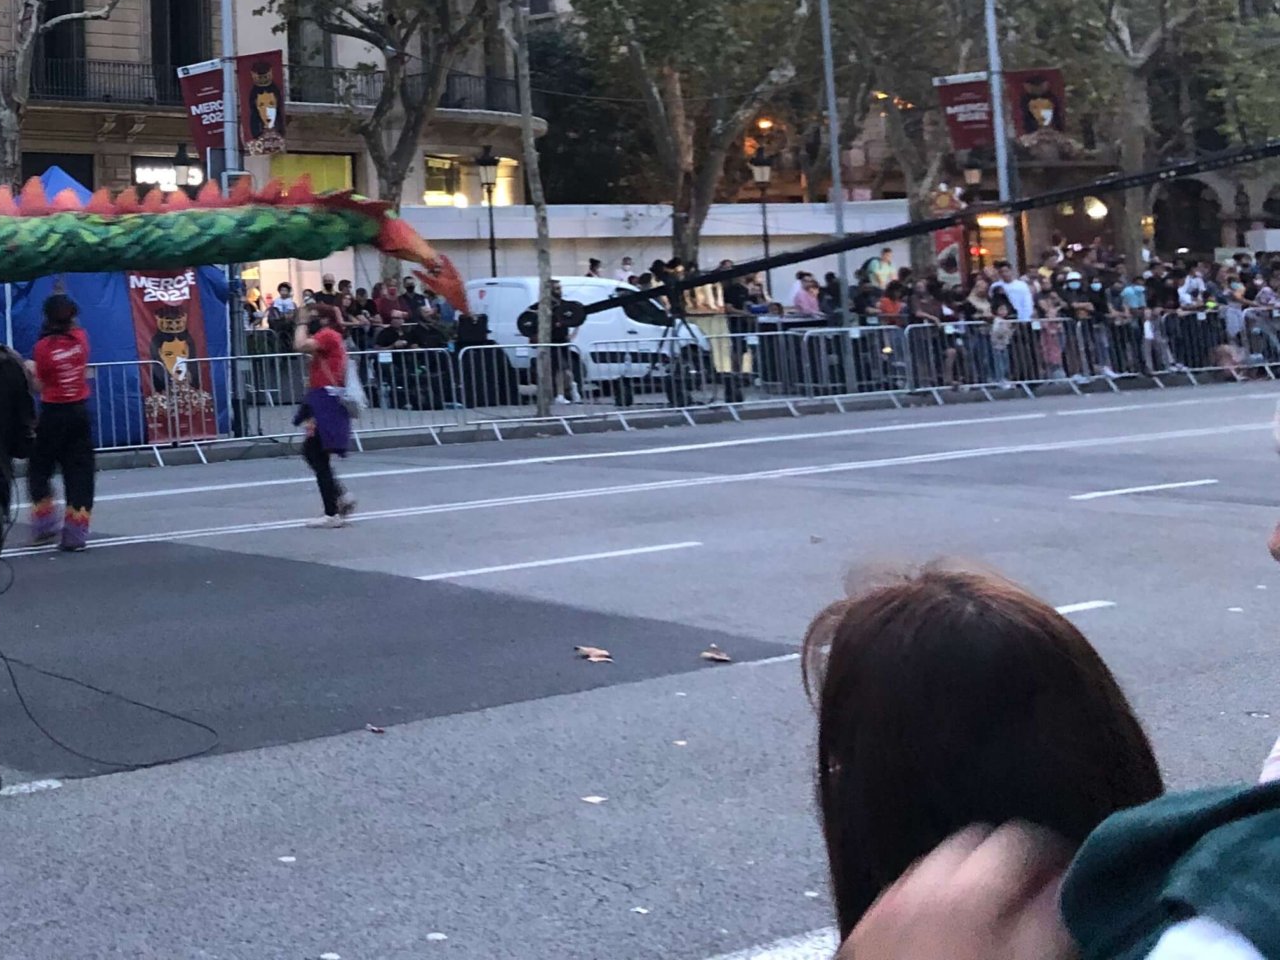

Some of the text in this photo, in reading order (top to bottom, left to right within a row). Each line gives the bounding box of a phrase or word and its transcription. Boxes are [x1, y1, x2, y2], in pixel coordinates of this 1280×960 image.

[190, 100, 225, 116] MERC
[201, 112, 225, 125] 202
[143, 286, 190, 302] 2021
